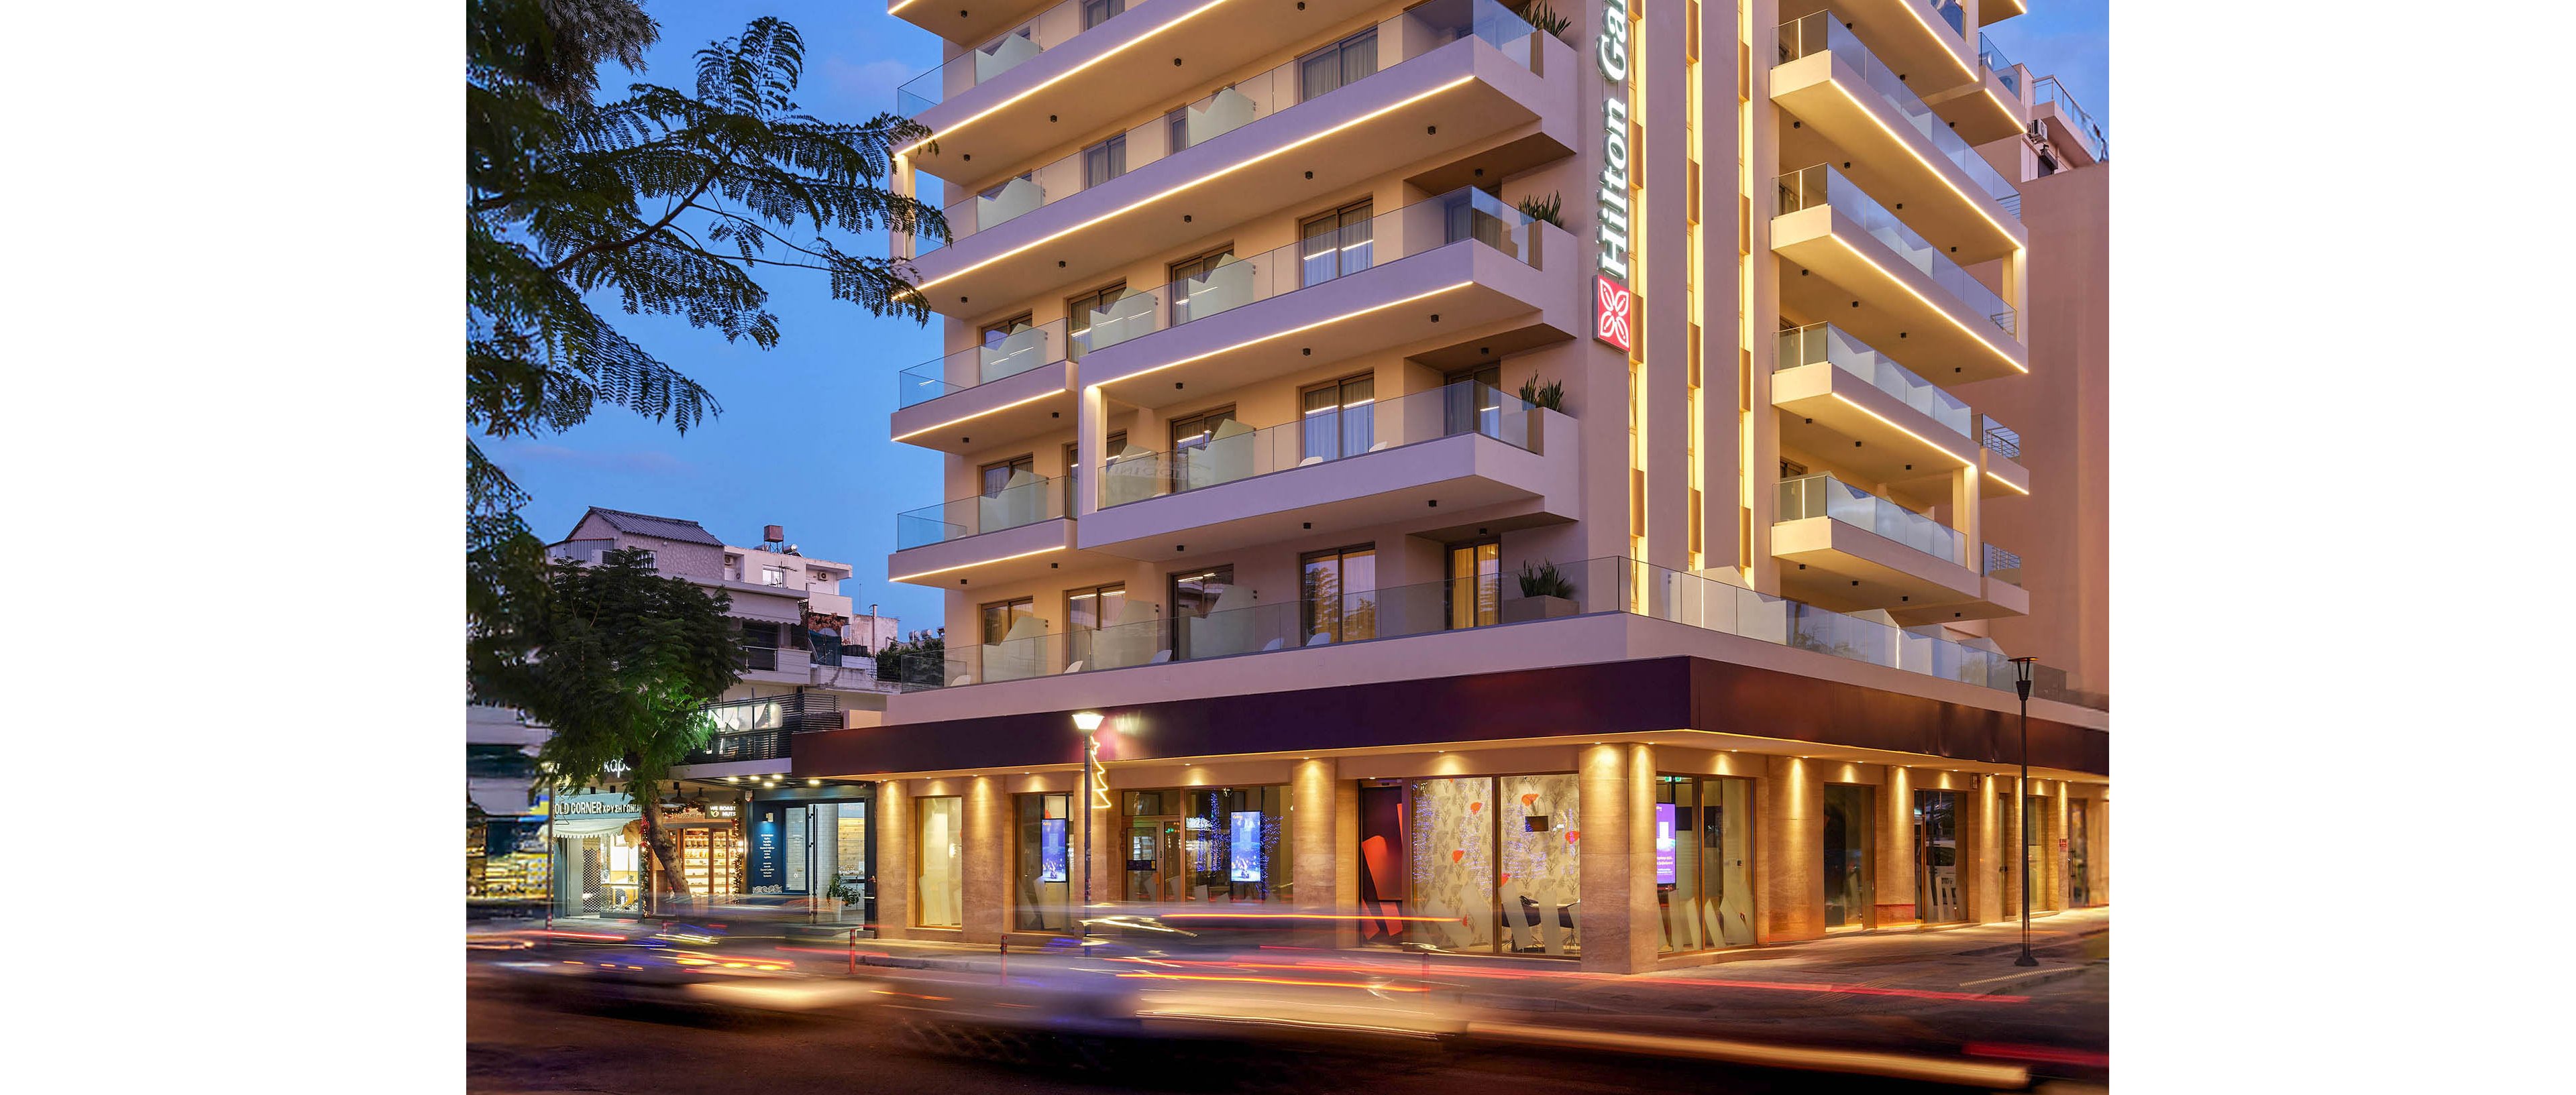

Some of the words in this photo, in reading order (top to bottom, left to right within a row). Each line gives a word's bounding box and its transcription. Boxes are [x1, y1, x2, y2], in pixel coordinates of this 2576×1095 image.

[1598, 98, 1627, 279] Hilton
[554, 803, 569, 815] OLD
[571, 801, 602, 814] CORNER
[602, 805, 623, 813] ΧΡΥΣΗ
